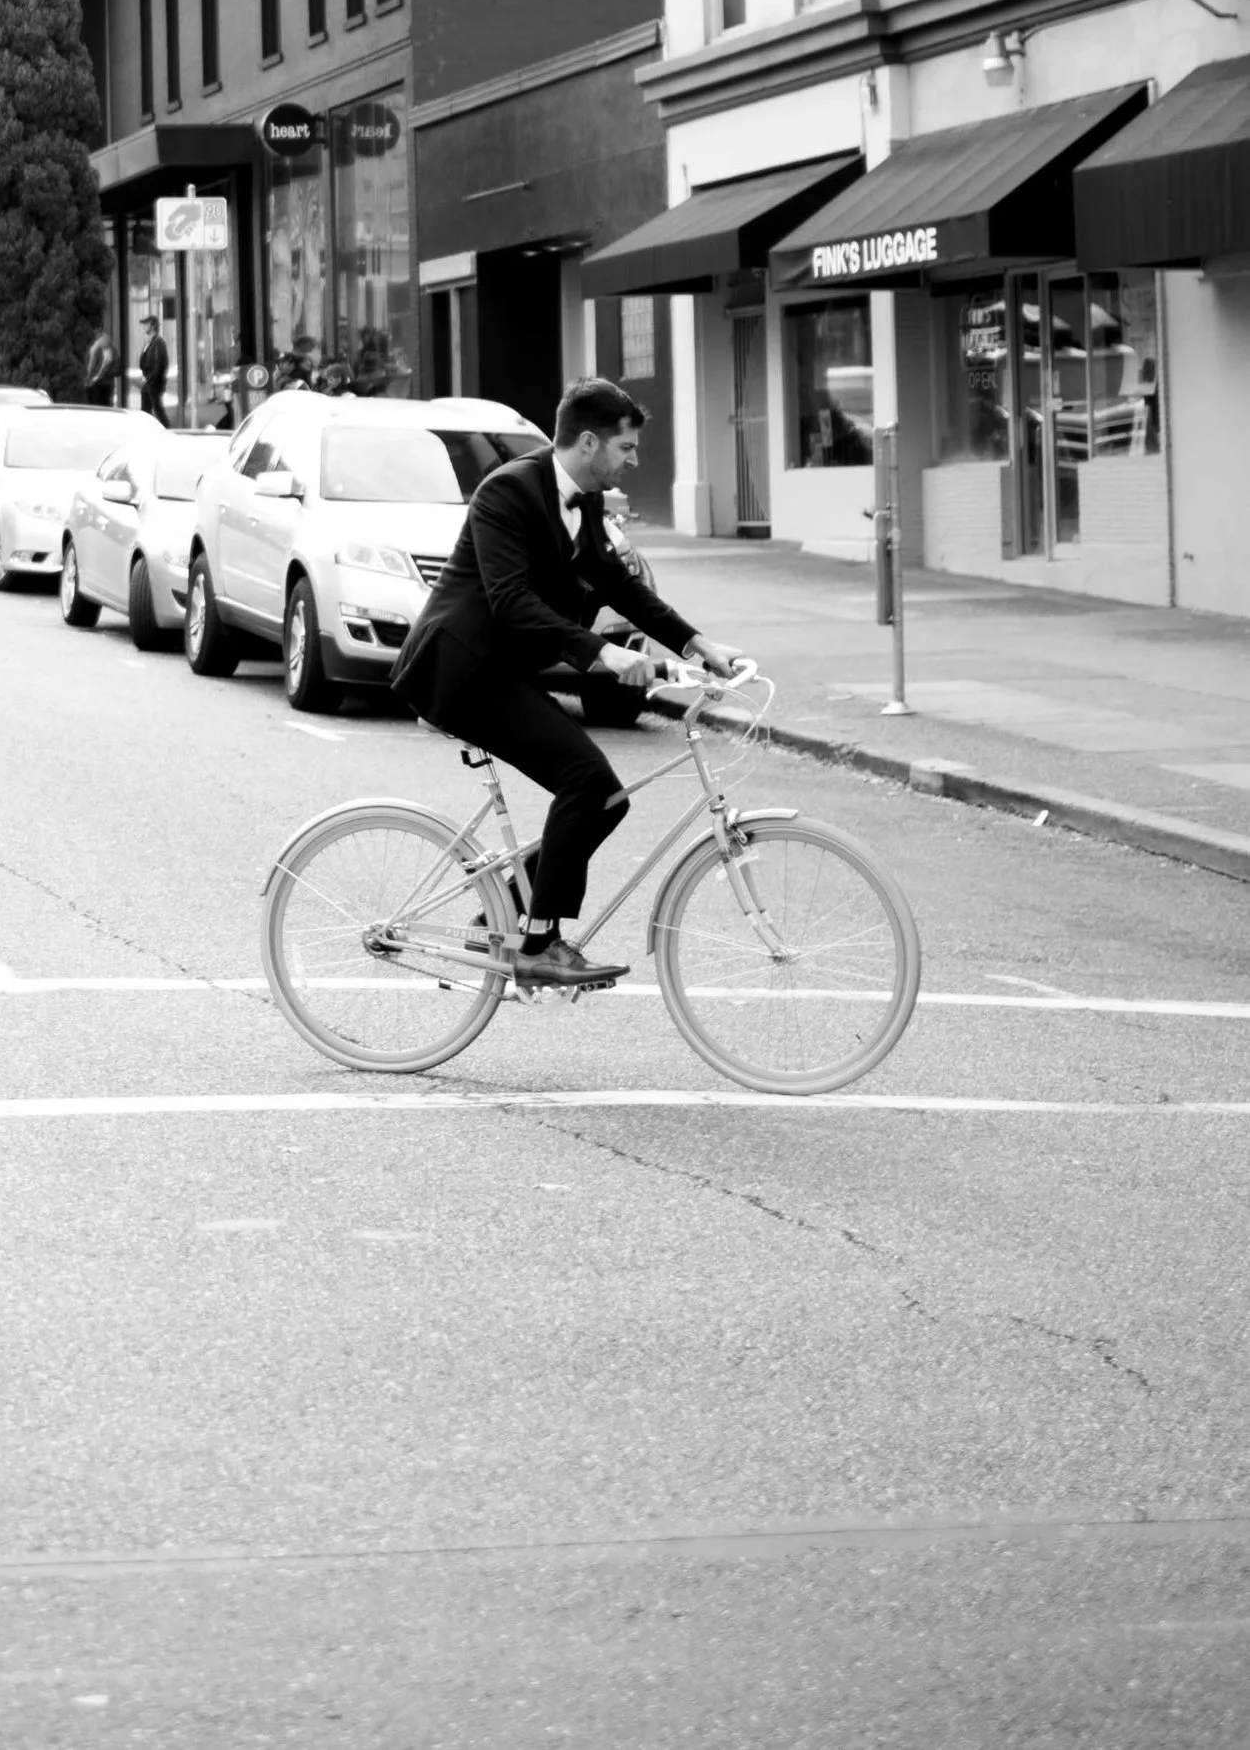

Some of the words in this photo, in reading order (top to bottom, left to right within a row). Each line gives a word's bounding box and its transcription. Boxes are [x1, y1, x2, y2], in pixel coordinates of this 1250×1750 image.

[270, 122, 310, 139] heart
[812, 240, 860, 279] FINK'S
[862, 226, 938, 271] LUGGAGE
